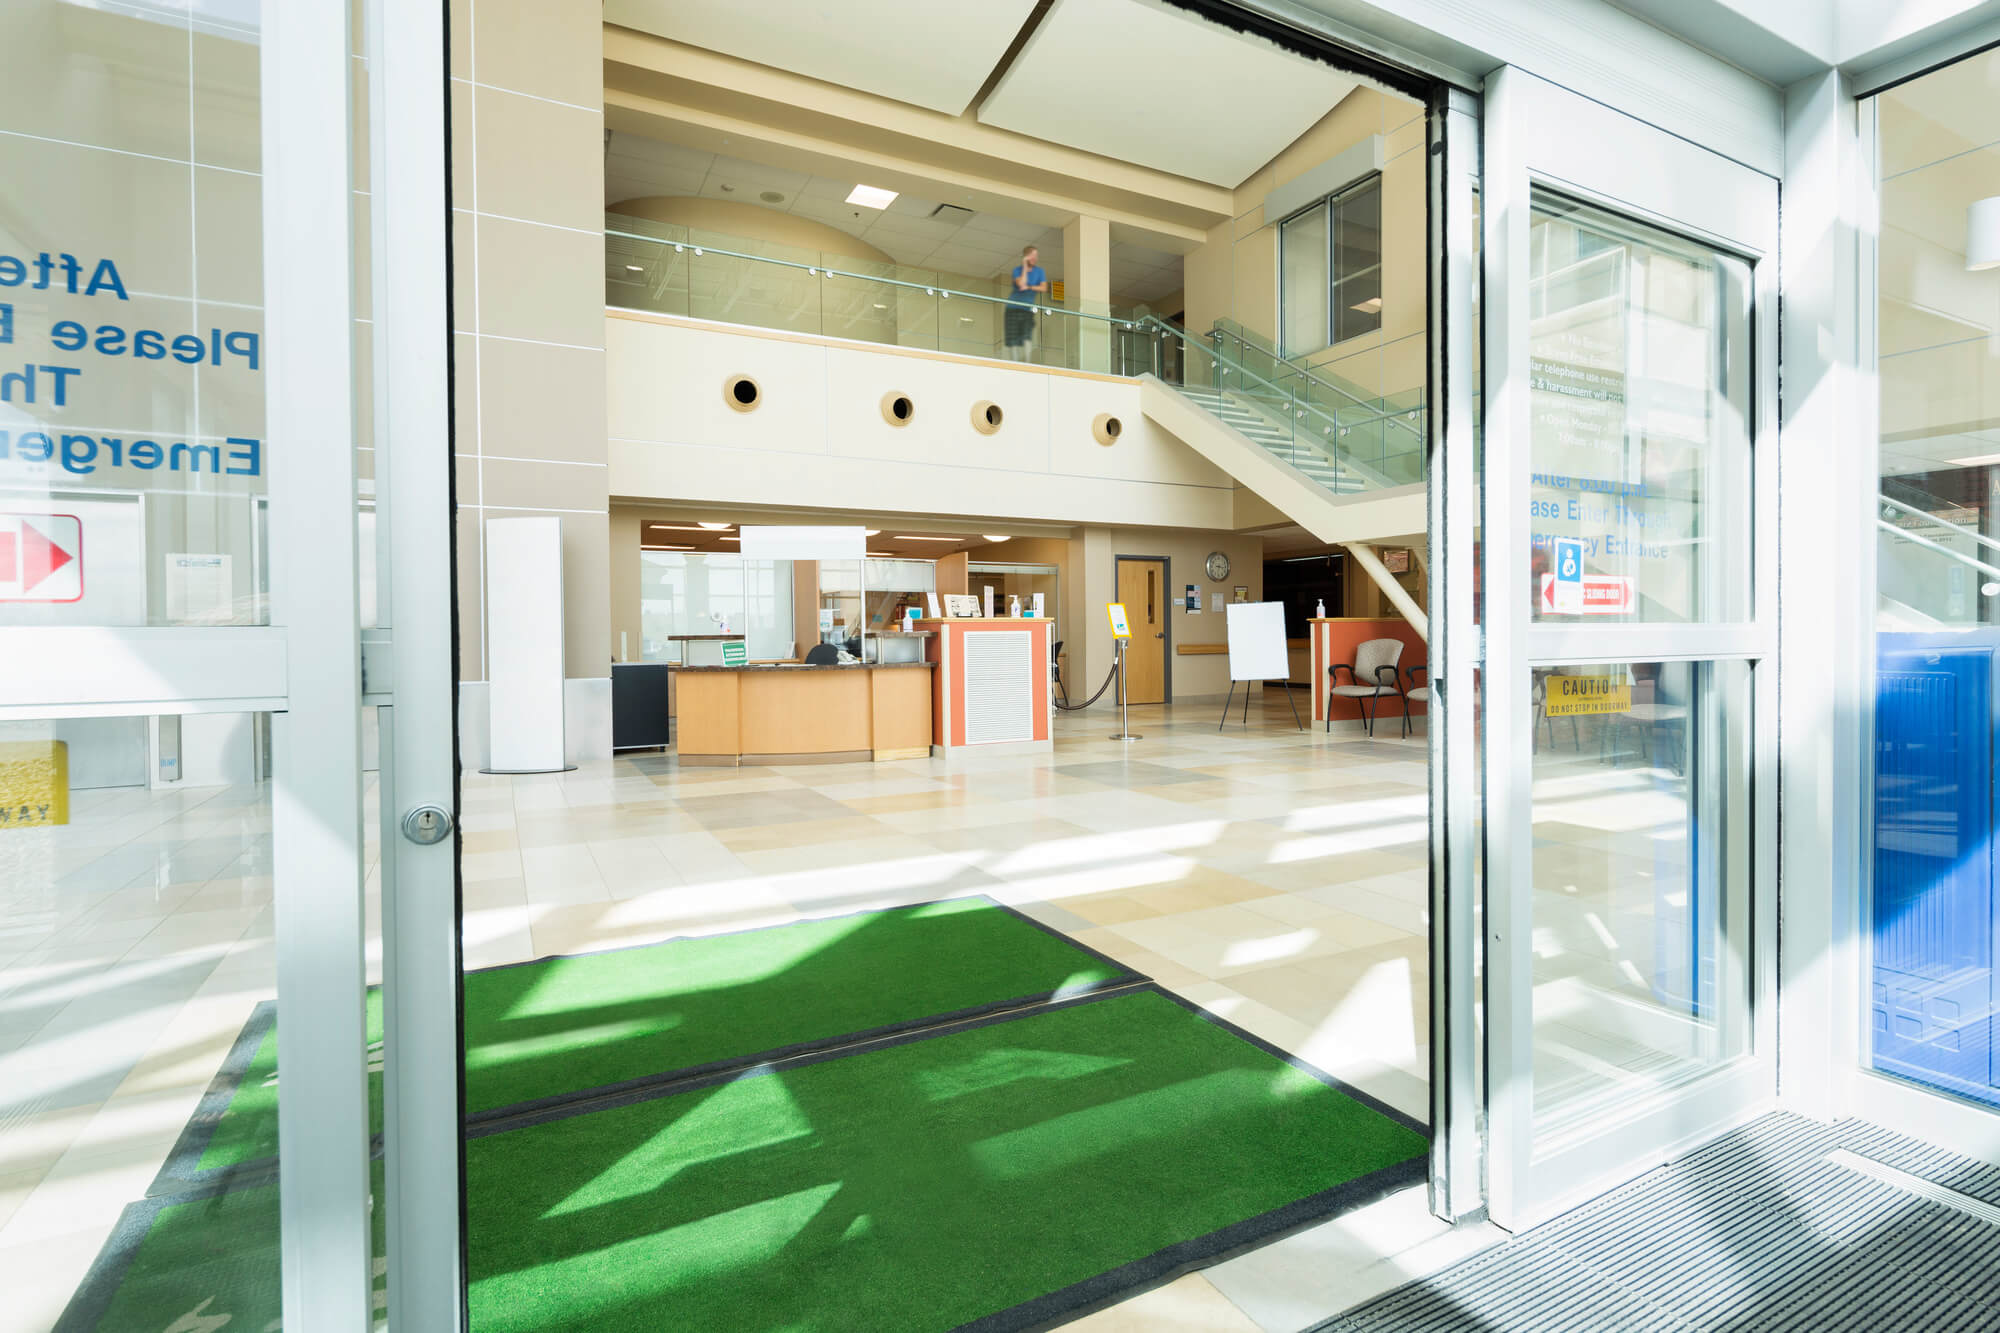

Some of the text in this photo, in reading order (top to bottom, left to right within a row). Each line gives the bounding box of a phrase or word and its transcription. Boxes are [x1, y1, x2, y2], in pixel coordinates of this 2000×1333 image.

[1544, 363, 1584, 379] telephone
[1546, 379, 1592, 398] harassment
[1593, 389, 1607, 400] will
[1568, 499, 1608, 524] Enter
[1606, 534, 1668, 559] Entrance
[1562, 679, 1618, 696] CAUTION
[1561, 704, 1573, 713] NOT
[1575, 703, 1590, 713] STOP
